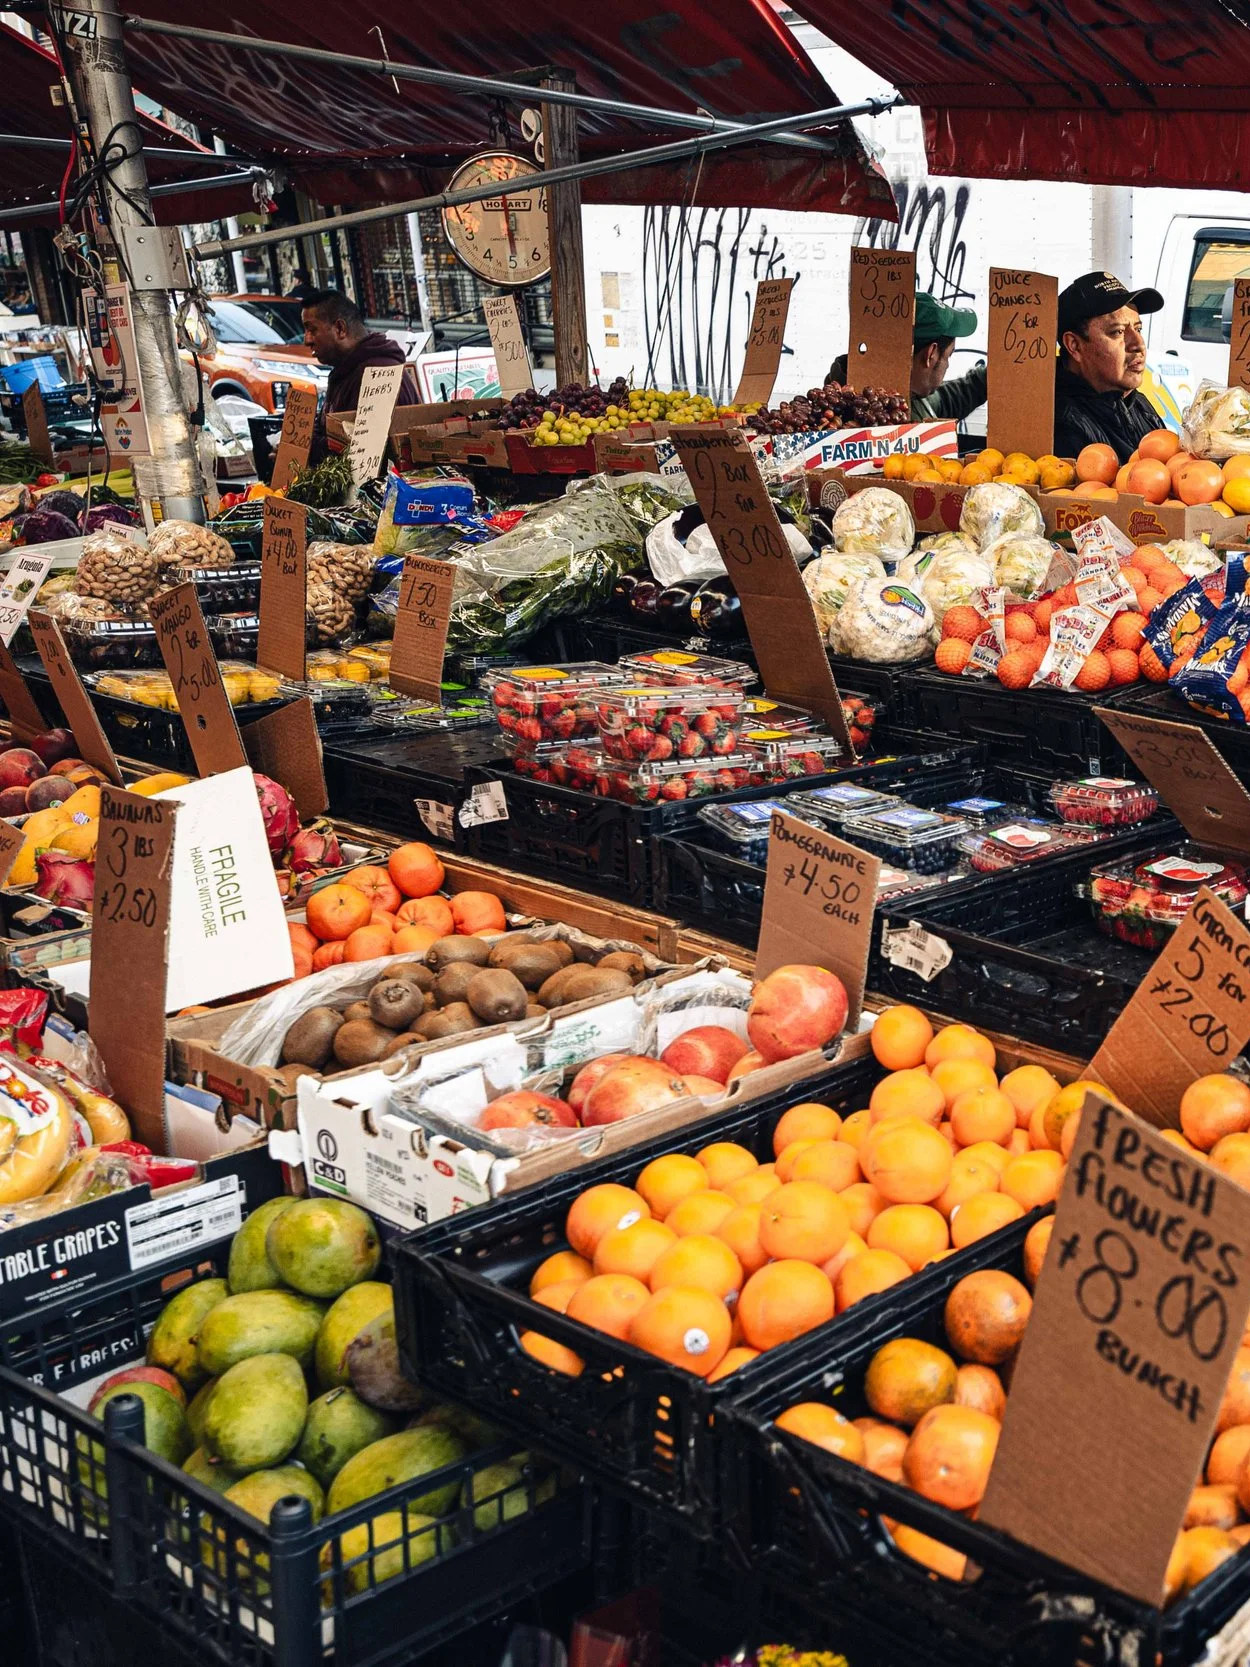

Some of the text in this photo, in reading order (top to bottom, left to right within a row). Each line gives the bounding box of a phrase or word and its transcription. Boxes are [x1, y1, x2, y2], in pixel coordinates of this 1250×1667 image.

[860, 266, 880, 300] 3
[754, 307, 766, 332] 3
[1004, 312, 1019, 350] 6
[284, 415, 296, 435] 3
[822, 441, 874, 463] FARM
[101, 790, 163, 823] BANANAS
[106, 826, 128, 878] 3
[189, 847, 218, 938] HANDLE WITH CARE
[209, 845, 246, 926] FRAGILE
[1174, 935, 1210, 982] 5
[314, 1159, 346, 1185] C&D
[1096, 1329, 1205, 1423] BUNCH
